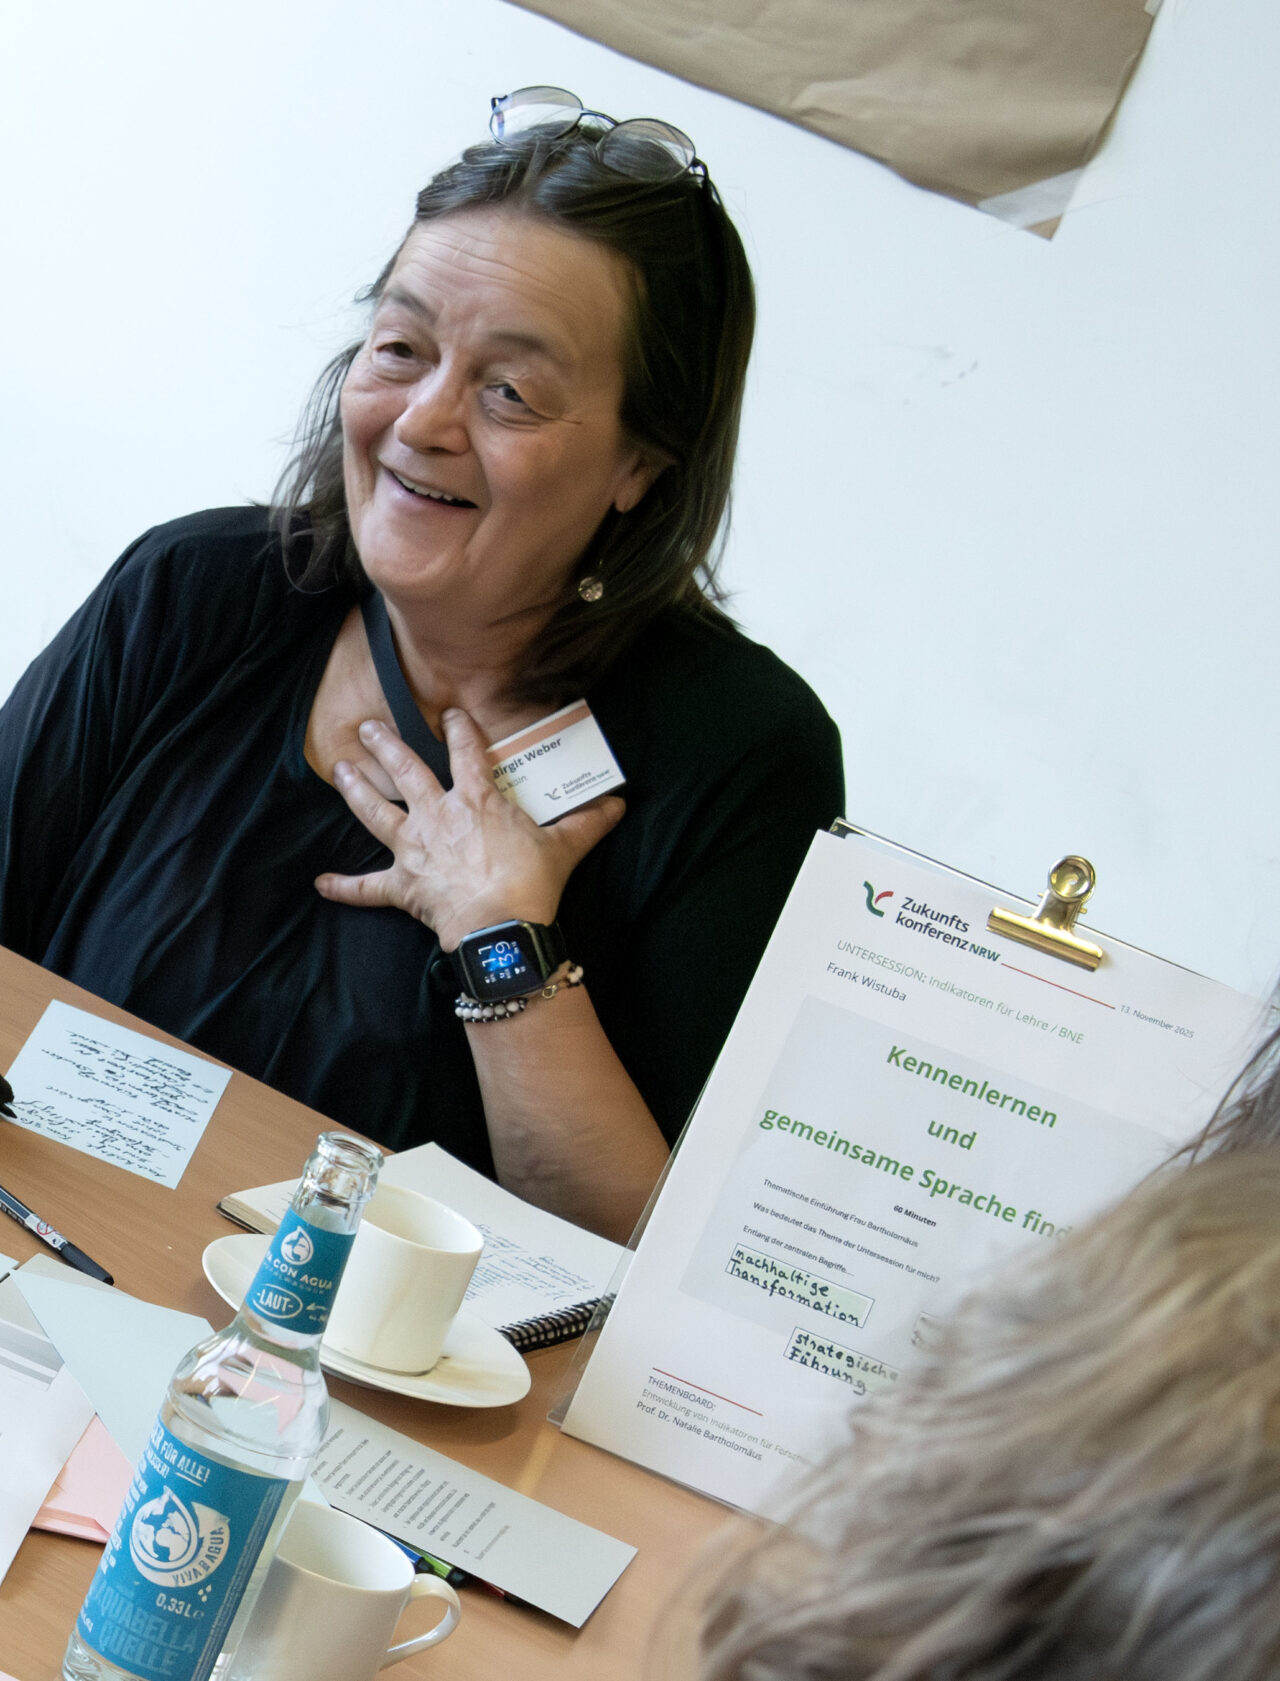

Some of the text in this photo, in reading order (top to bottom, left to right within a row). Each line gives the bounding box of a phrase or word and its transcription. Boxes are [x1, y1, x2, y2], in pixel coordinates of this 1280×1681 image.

[524, 738, 562, 763] Weber
[901, 896, 970, 934] Zukunfts
[895, 911, 1001, 963] konferenz NRW
[826, 961, 907, 1002] Frank Wistuba
[928, 976, 994, 1011] Indikatoren
[995, 1000, 1015, 1017] für
[1016, 1009, 1050, 1032] Lehre
[1058, 1025, 1084, 1045] BNE
[1132, 1008, 1174, 1030] November
[1174, 1024, 1195, 1039] 2025
[886, 1045, 1058, 1128] Kennenlernen
[927, 1118, 977, 1151] und
[759, 1108, 915, 1182] gemeinsame
[918, 1168, 1017, 1223] Sprache
[849, 1214, 867, 1228] Frau
[904, 1207, 937, 1228] Minuten
[273, 1258, 298, 1278] CON
[300, 1274, 333, 1289] AGUA
[730, 1258, 860, 1327] Transformation
[647, 1375, 717, 1412] THEMENBOARD:
[636, 1401, 657, 1416] Prof.
[657, 1410, 671, 1422] Dr.
[672, 1416, 702, 1436] Natalie
[161, 1438, 211, 1484] FÜR ALLE!
